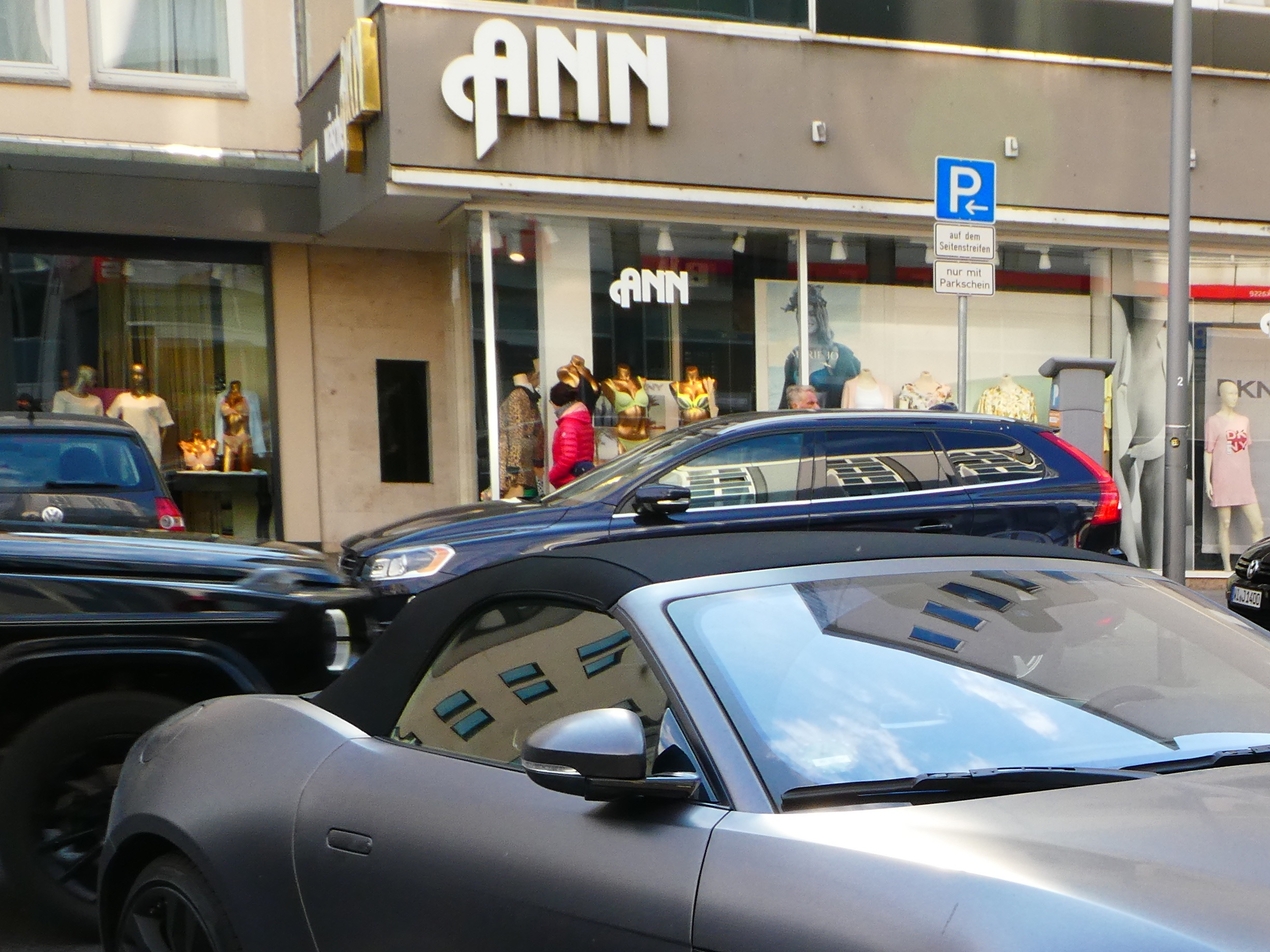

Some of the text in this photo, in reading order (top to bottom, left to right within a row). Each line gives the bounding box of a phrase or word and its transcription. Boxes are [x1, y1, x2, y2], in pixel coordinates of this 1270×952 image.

[441, 18, 669, 160] ANN
[950, 165, 982, 213] P
[949, 231, 981, 241] auf dem
[939, 241, 991, 253] Seitenstreifen
[946, 268, 982, 277] nur mit
[609, 267, 689, 309] ANN
[939, 278, 990, 290] Parkschein
[1177, 376, 1184, 387] 2
